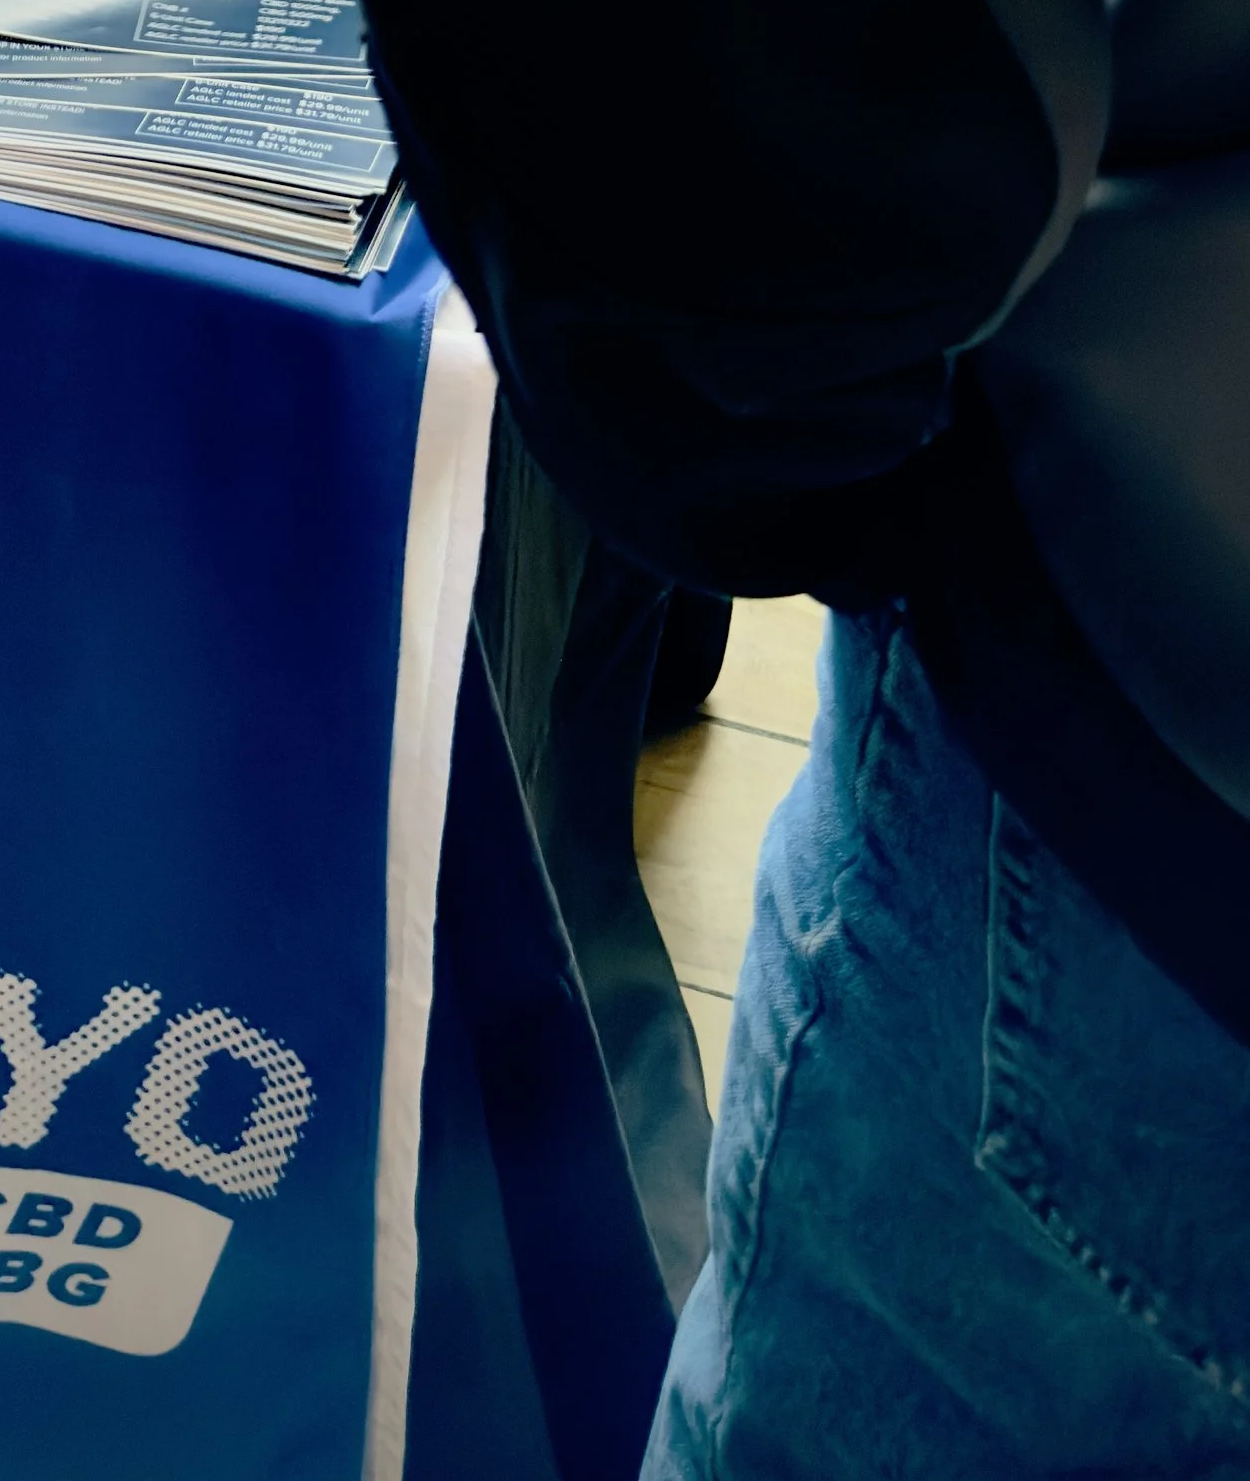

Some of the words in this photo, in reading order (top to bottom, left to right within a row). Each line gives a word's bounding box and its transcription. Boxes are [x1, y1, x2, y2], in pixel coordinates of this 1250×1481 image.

[11, 54, 48, 63] product
[50, 54, 102, 63] information
[187, 93, 220, 104] AGLC
[222, 98, 263, 110] retailer
[263, 104, 293, 116] price
[190, 86, 223, 96] AGLC
[225, 90, 265, 101] landed
[267, 95, 291, 105] cost
[147, 124, 181, 135] AGLC
[182, 128, 223, 141] retailer
[224, 135, 255, 147] price
[152, 116, 187, 127] AGLC
[188, 121, 228, 133] landed
[229, 127, 254, 138] cost
